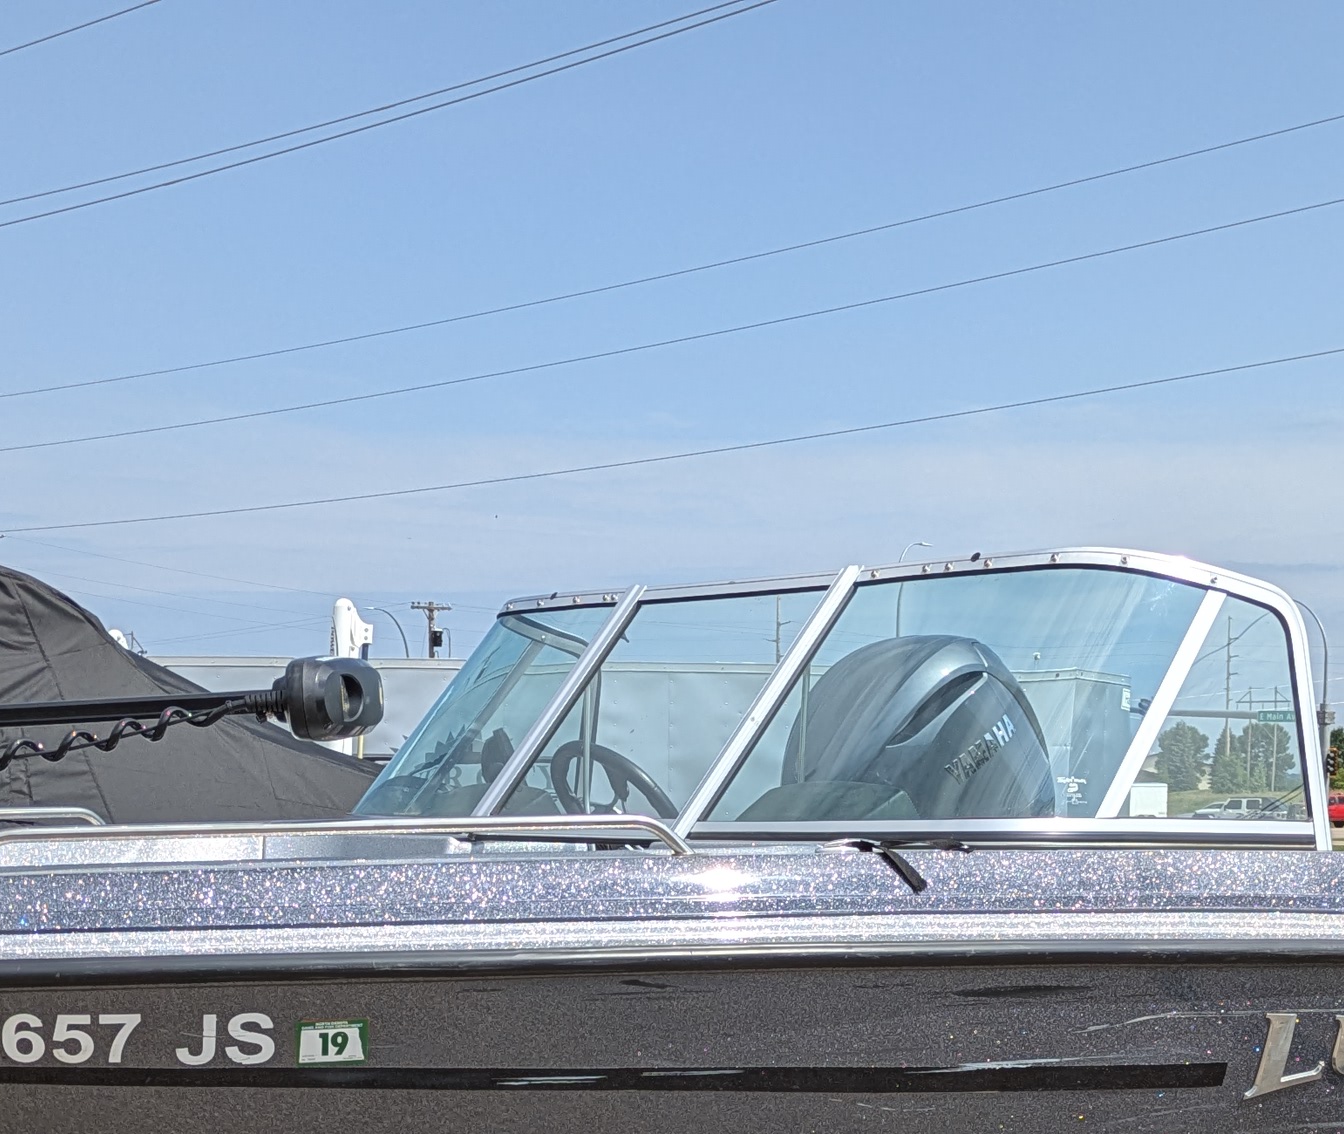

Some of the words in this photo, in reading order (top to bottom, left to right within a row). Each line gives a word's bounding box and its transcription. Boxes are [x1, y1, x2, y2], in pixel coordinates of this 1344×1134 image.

[1259, 712, 1264, 721] E
[1266, 712, 1284, 720] Main
[944, 714, 1016, 785] YAMAHA
[1, 1013, 142, 1064] 657
[175, 1013, 275, 1066] JS
[319, 1031, 349, 1056] 19
